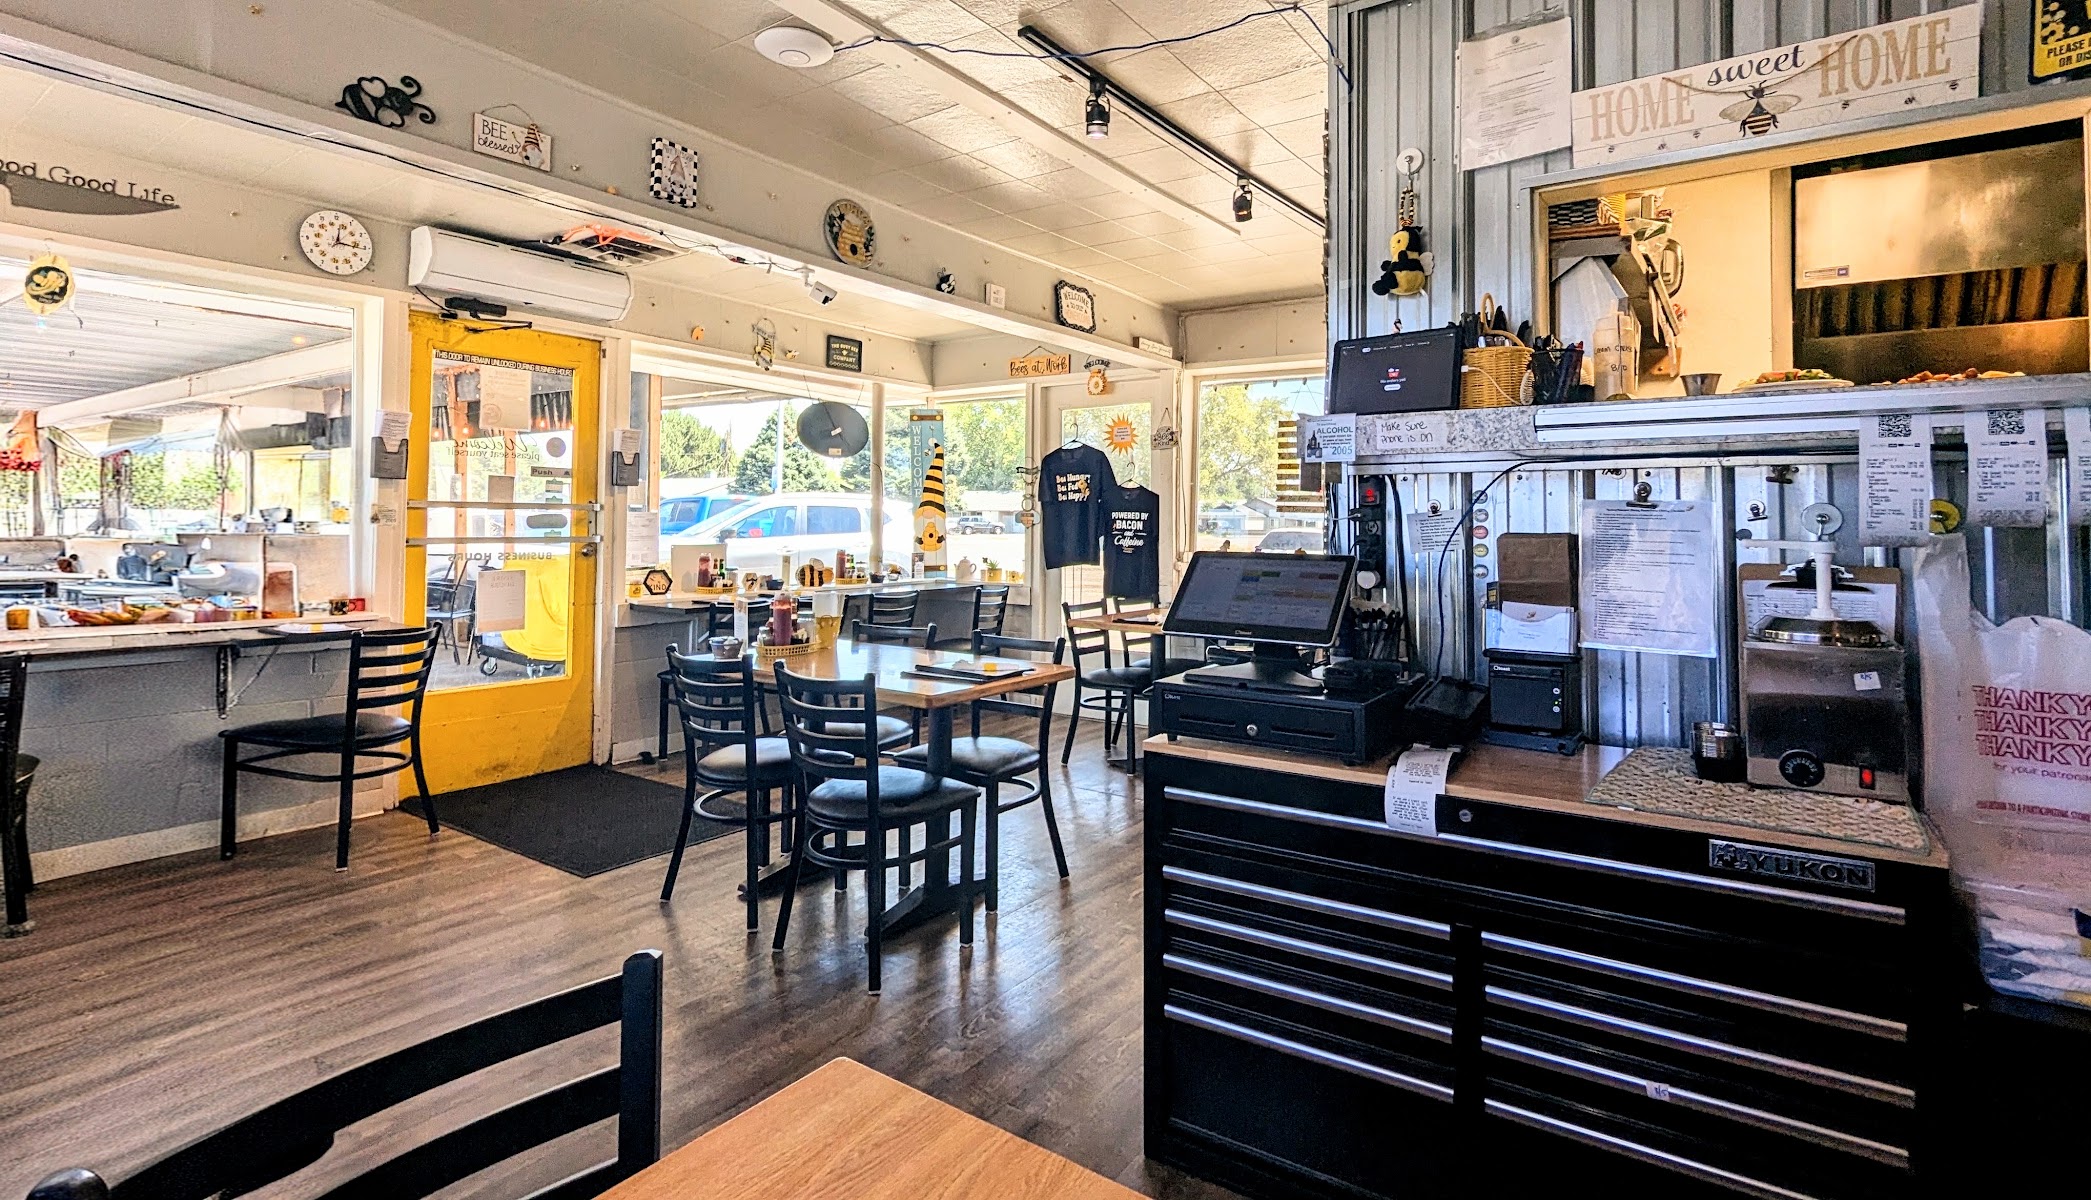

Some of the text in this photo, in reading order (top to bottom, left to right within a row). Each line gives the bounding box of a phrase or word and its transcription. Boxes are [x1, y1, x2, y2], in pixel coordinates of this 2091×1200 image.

[2047, 39, 2086, 58] PLEASE
[1590, 73, 1694, 142] HOME
[1706, 44, 1805, 86] sweet
[1816, 17, 1952, 98] HOME
[481, 118, 508, 141] BEE
[477, 135, 518, 155] blessed
[48, 165, 117, 195] Good
[127, 182, 175, 207] Life
[1063, 290, 1090, 308] WELCOME
[435, 351, 573, 376] THIS DOOR TO REMAIN UNLOCKED DURING BUSINESS HOURS
[833, 354, 857, 363] COMPANY
[1083, 358, 1111, 370] WELCOME
[1316, 425, 1354, 435] ALCOHOL
[1381, 421, 1401, 433] Make
[1407, 434, 1416, 443] is
[1331, 445, 1353, 455] 2005
[911, 425, 923, 498] WELCOME
[532, 468, 553, 476] Push
[1111, 511, 1149, 520] POWERED BY
[1115, 519, 1143, 530] BACON
[1114, 535, 1144, 548] Caffeine
[2011, 765, 2037, 775] your
[1747, 851, 1870, 887] YUKON
